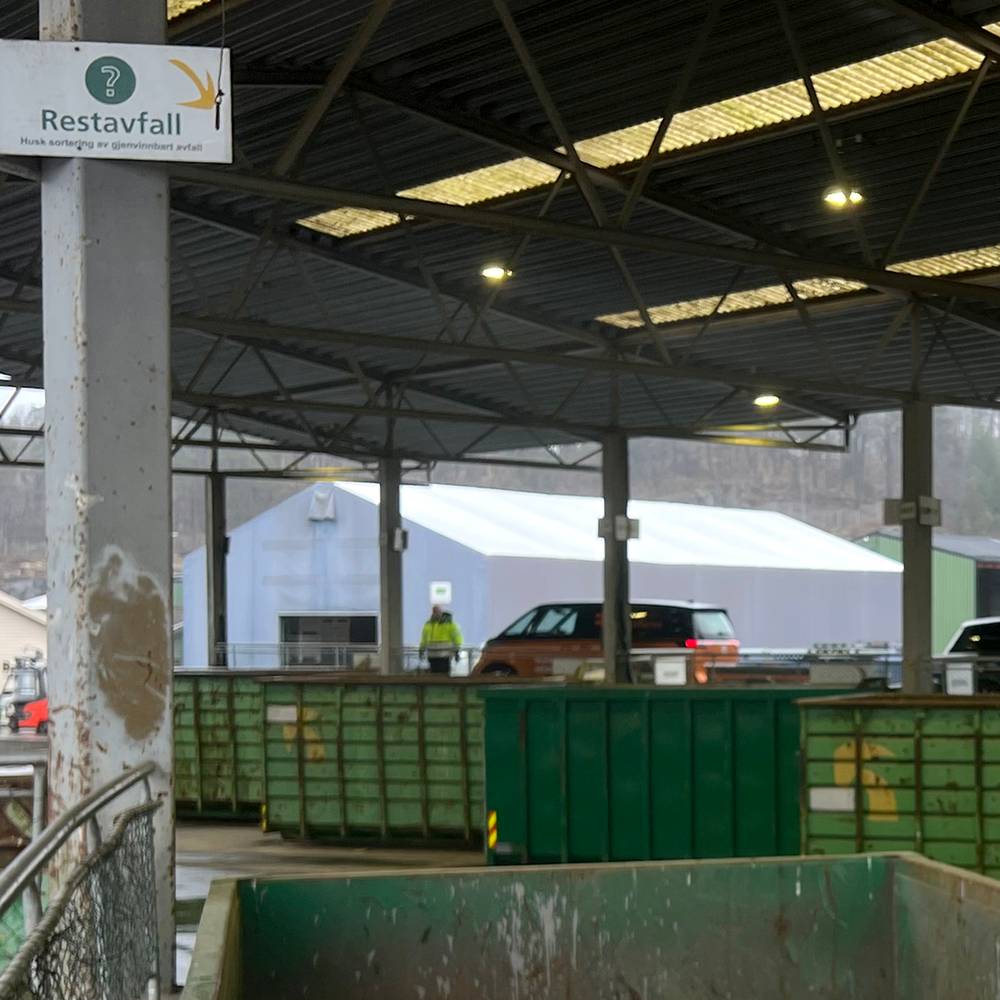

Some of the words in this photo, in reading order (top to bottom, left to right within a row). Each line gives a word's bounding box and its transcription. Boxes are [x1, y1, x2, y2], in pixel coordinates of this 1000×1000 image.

[41, 109, 181, 136] Restavfall
[20, 136, 47, 146] Husk
[49, 138, 94, 149] sortering
[176, 142, 203, 152] avfall
